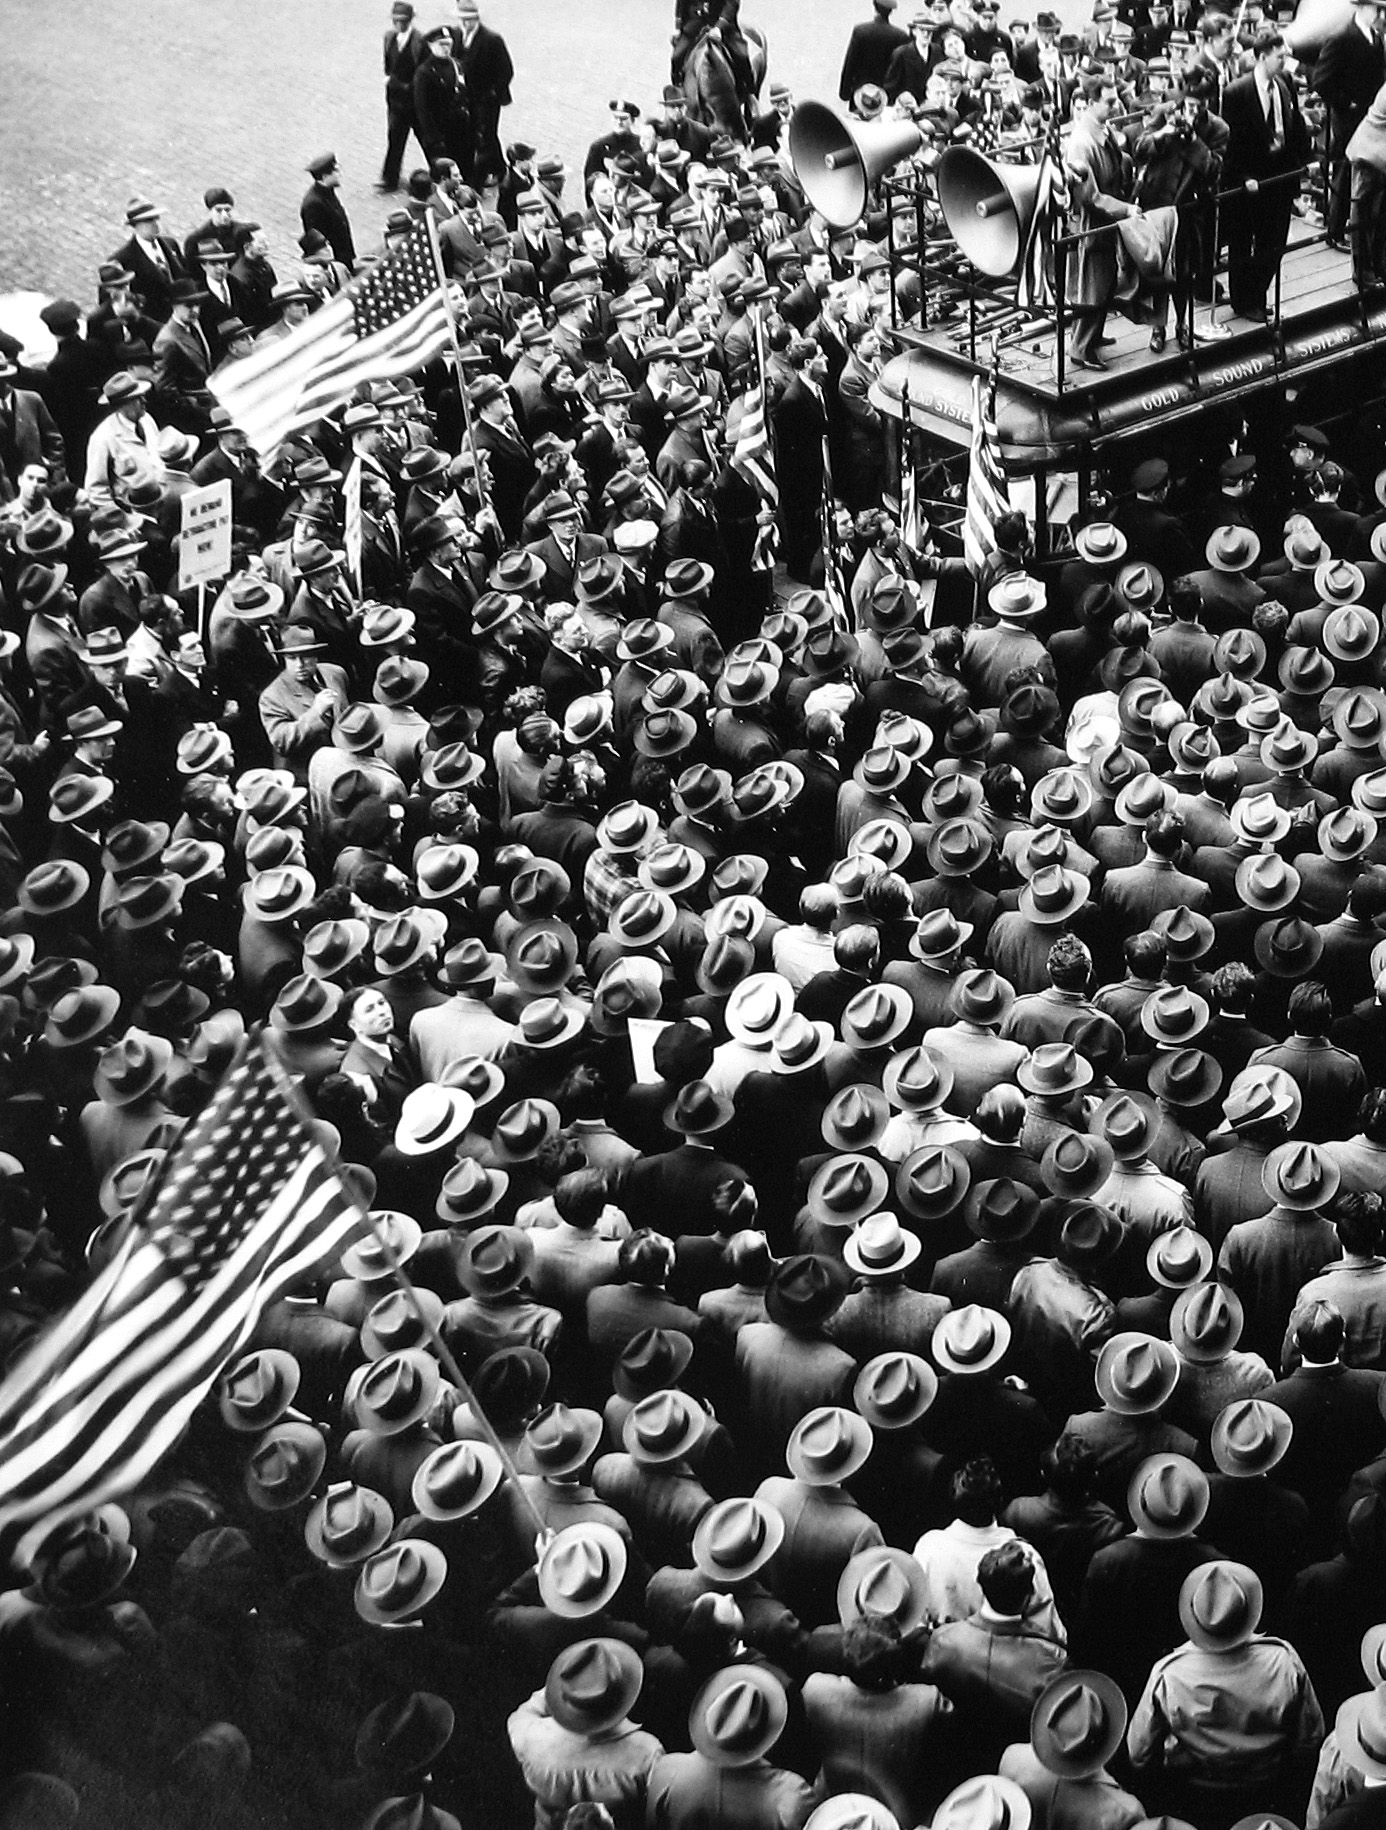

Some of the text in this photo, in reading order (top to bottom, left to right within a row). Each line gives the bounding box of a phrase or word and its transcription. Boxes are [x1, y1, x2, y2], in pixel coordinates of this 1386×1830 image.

[1141, 387, 1179, 411] GOLD
[1213, 358, 1263, 386] SOUND
[934, 399, 973, 424] SYSTE
